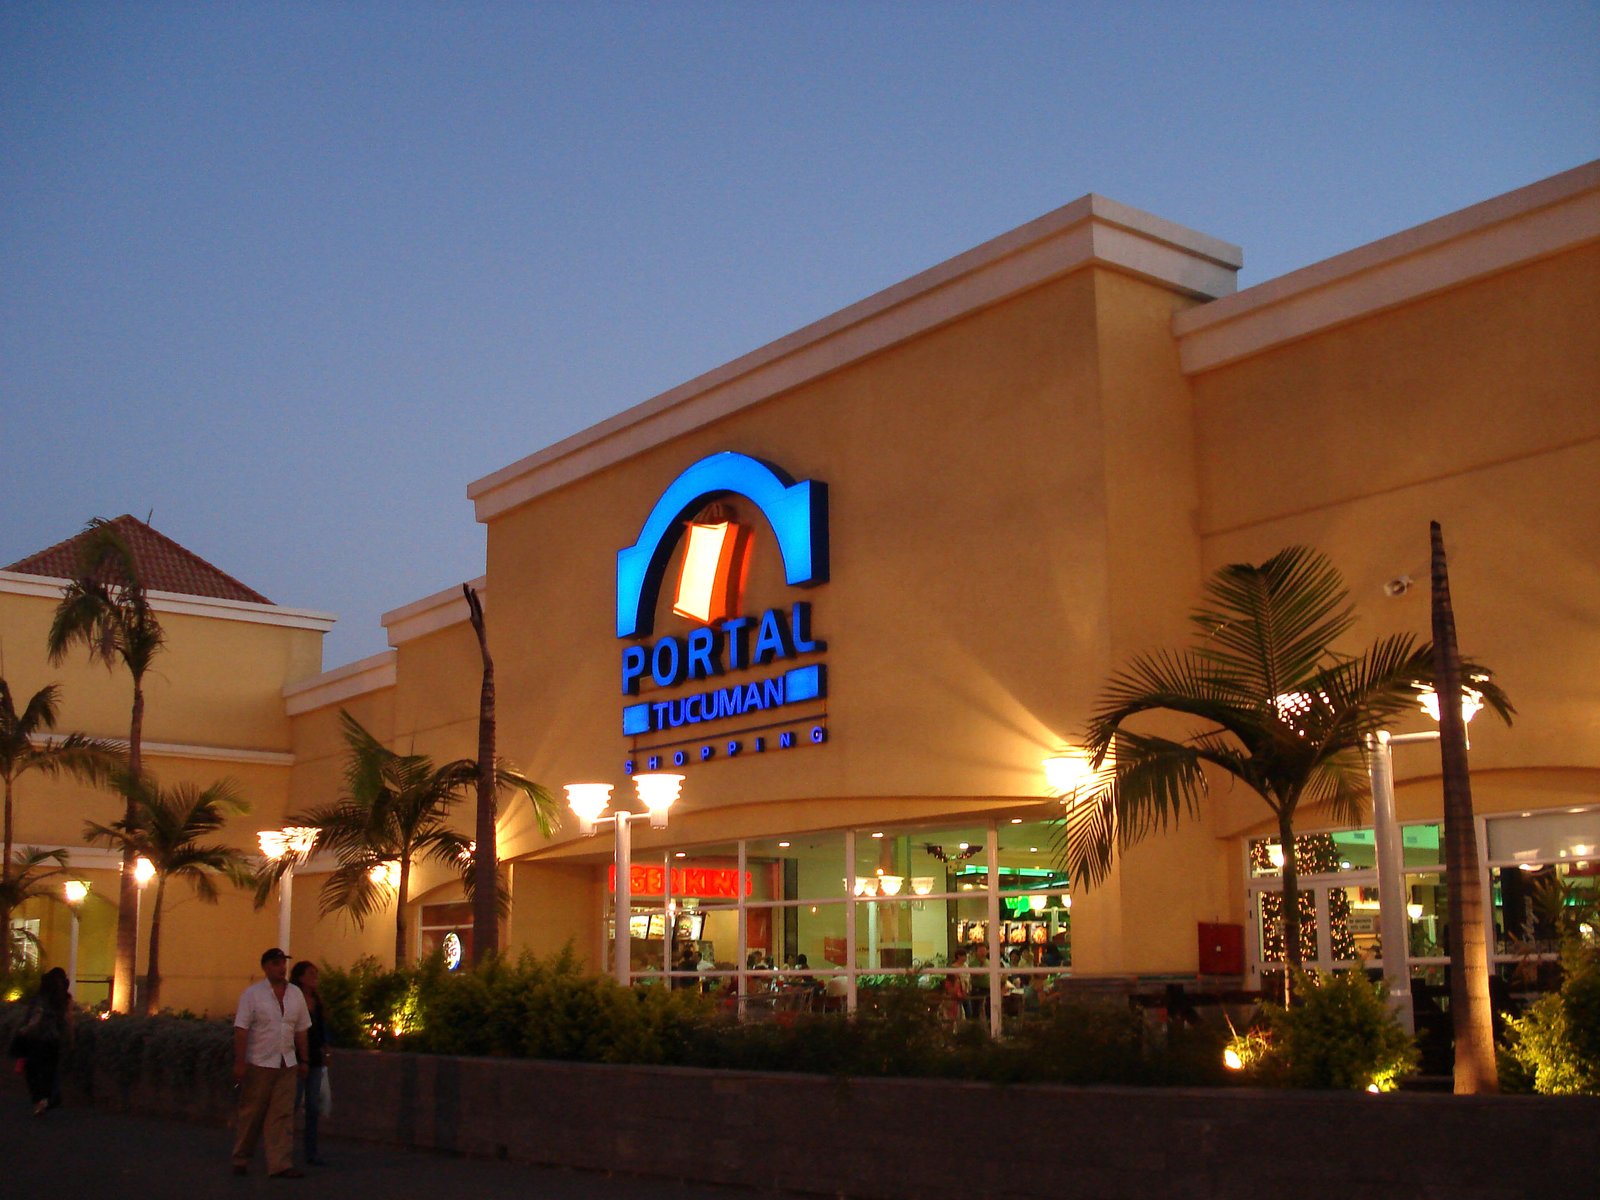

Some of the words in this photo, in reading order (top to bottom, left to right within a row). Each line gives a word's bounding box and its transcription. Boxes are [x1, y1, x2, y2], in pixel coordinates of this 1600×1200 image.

[621, 602, 824, 695] PORTAL
[652, 676, 785, 730] TUCUMAN
[624, 726, 826, 775] SHOPPING
[683, 868, 753, 898] KING
